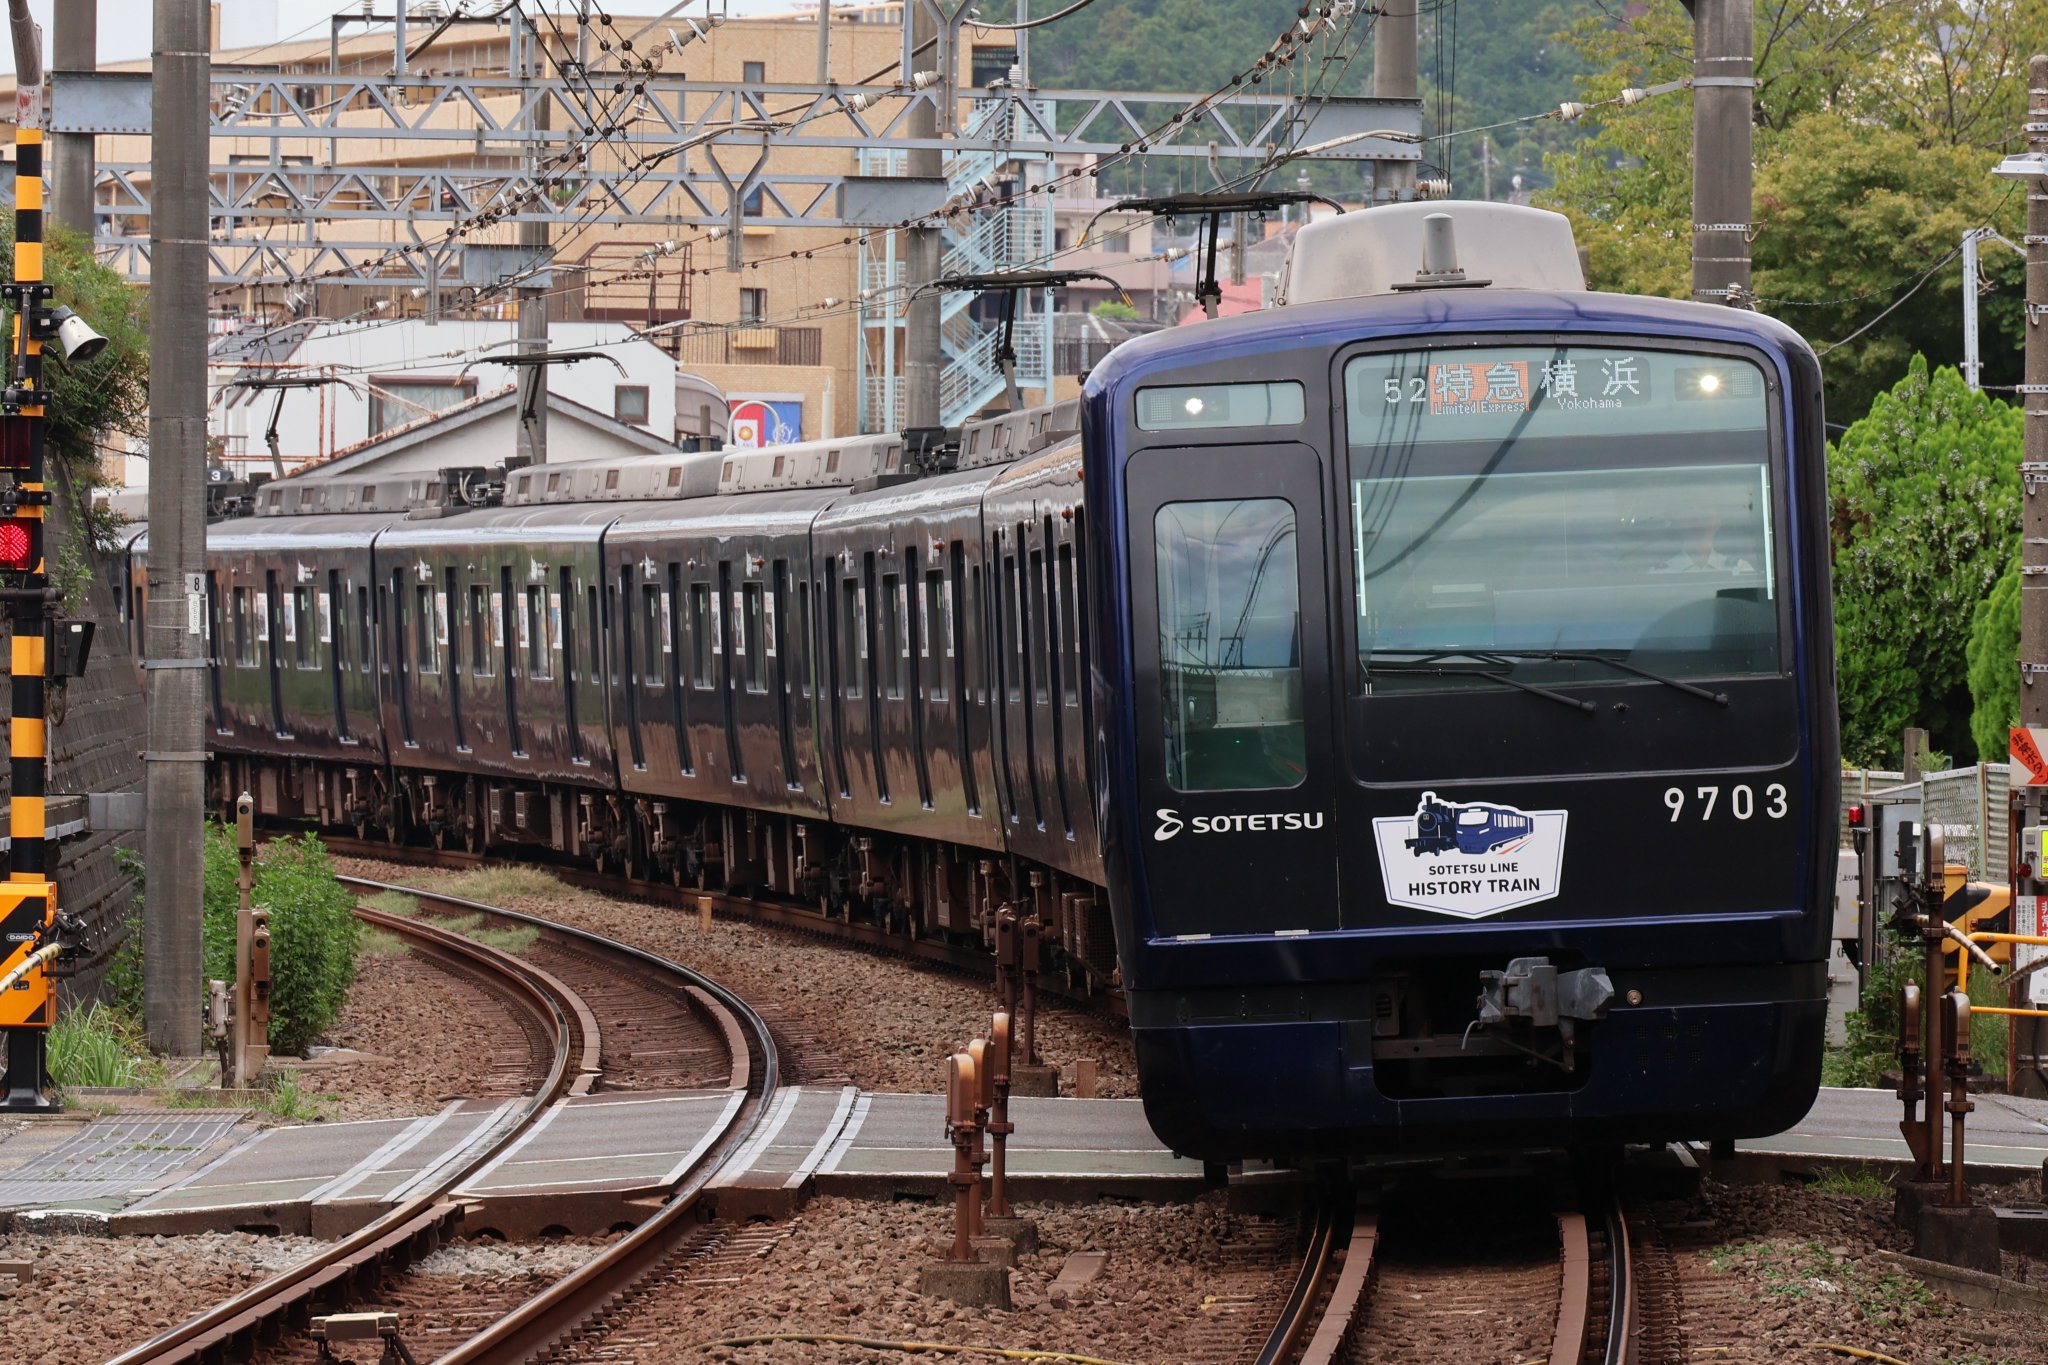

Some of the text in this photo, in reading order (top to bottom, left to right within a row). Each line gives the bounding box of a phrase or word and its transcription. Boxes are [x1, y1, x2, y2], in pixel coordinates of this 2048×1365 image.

[1436, 362, 1523, 402] 特急
[1541, 357, 1639, 398] 横浜
[1385, 377, 1427, 403] 52
[1435, 399, 1525, 415] Limited Express
[1557, 397, 1622, 410] Yokohama
[211, 470, 221, 481] 3
[194, 577, 200, 591] 8
[1664, 783, 1788, 822] 9703
[1192, 812, 1324, 834] SOTETSU
[1428, 863, 1519, 875] SOTETSU LINE
[1409, 878, 1540, 896] HISTORY TRAIN
